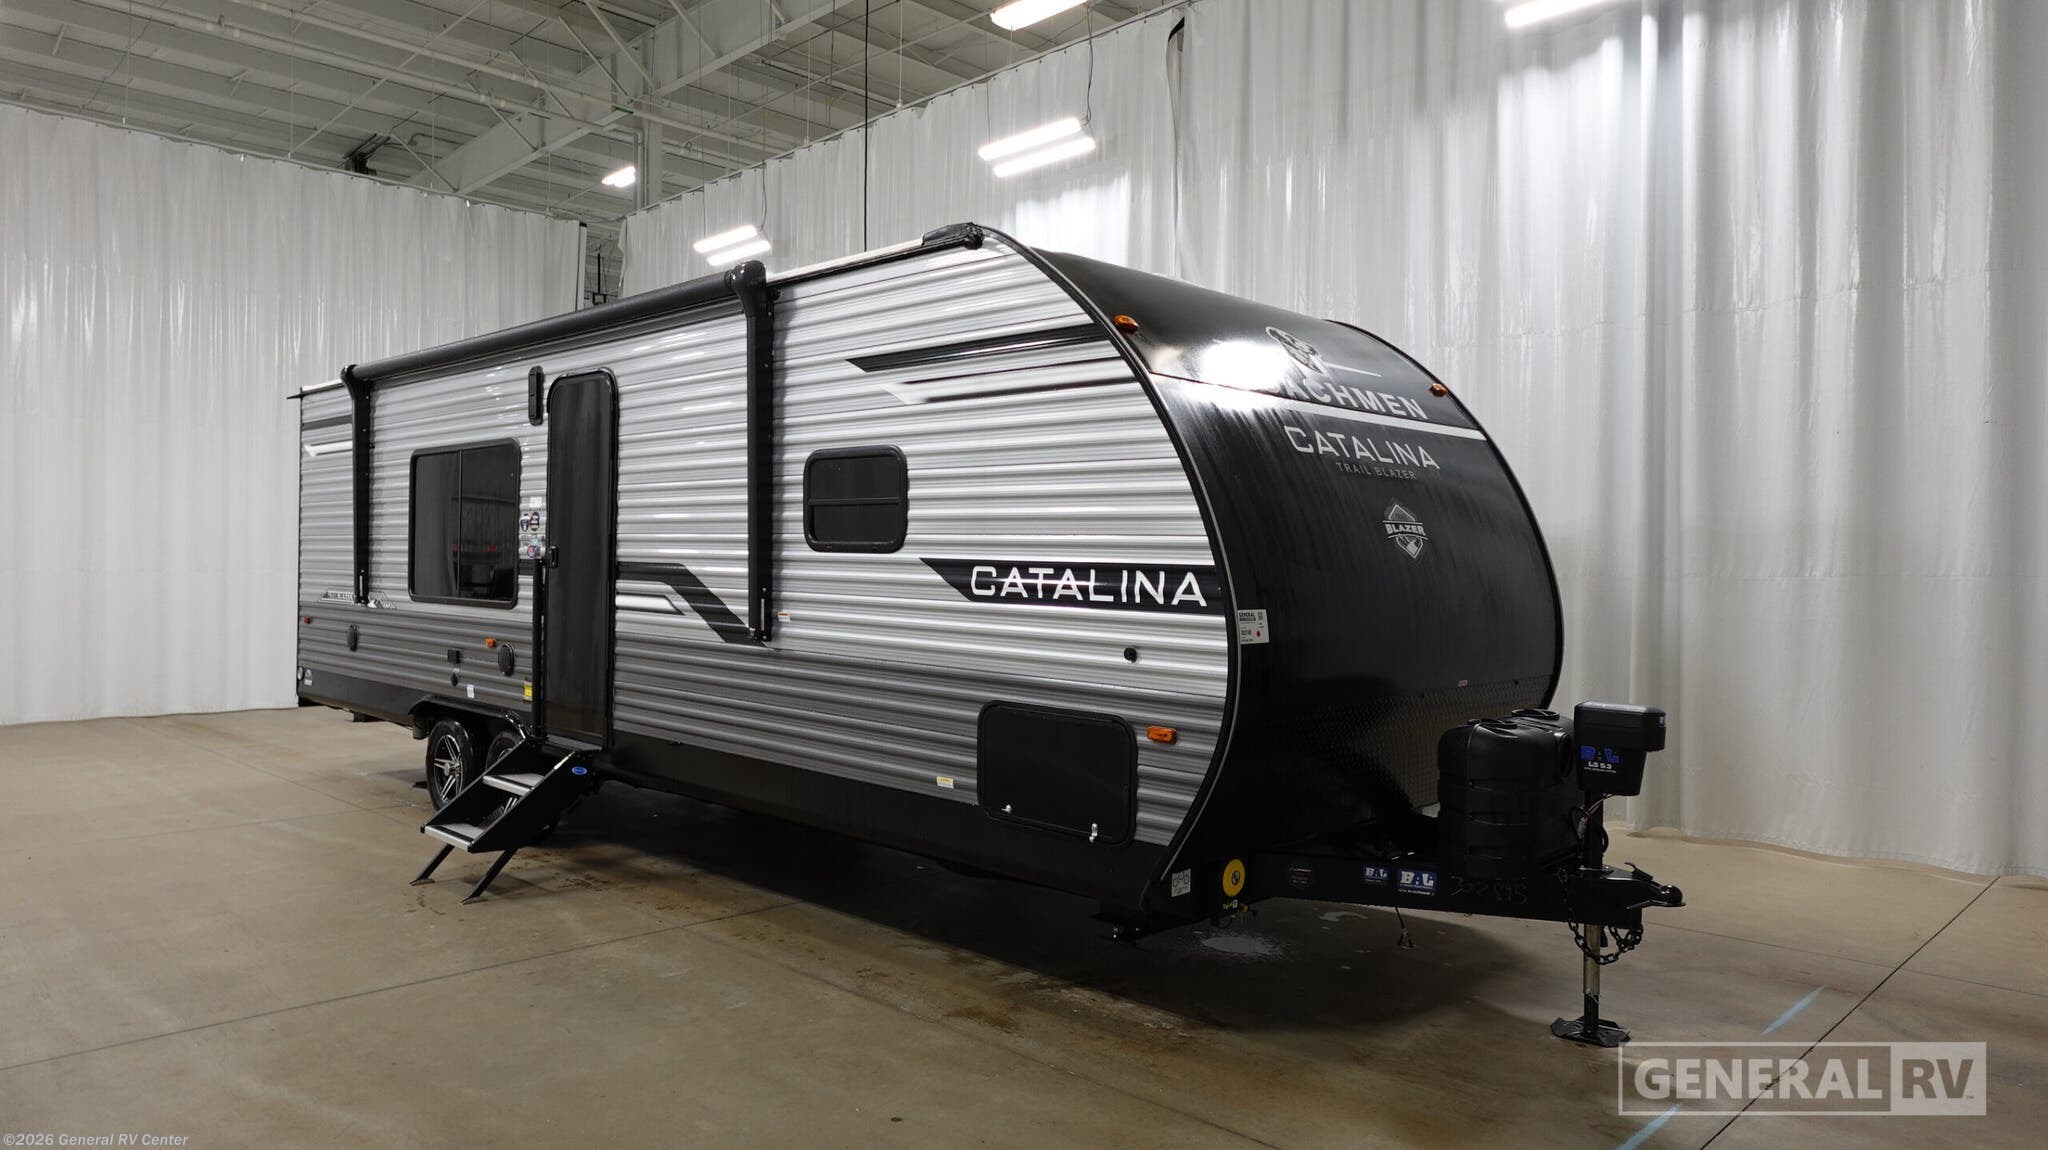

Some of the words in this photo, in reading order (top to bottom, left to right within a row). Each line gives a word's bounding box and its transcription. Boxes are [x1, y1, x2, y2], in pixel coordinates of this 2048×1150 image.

[1278, 374, 1428, 419] ACHMEN
[1283, 424, 1441, 470] CATALINA
[1335, 461, 1372, 476] TRAIL
[1375, 467, 1418, 481] BLAZER
[1384, 523, 1427, 537] BLAZER
[970, 565, 1208, 607] CATALINA
